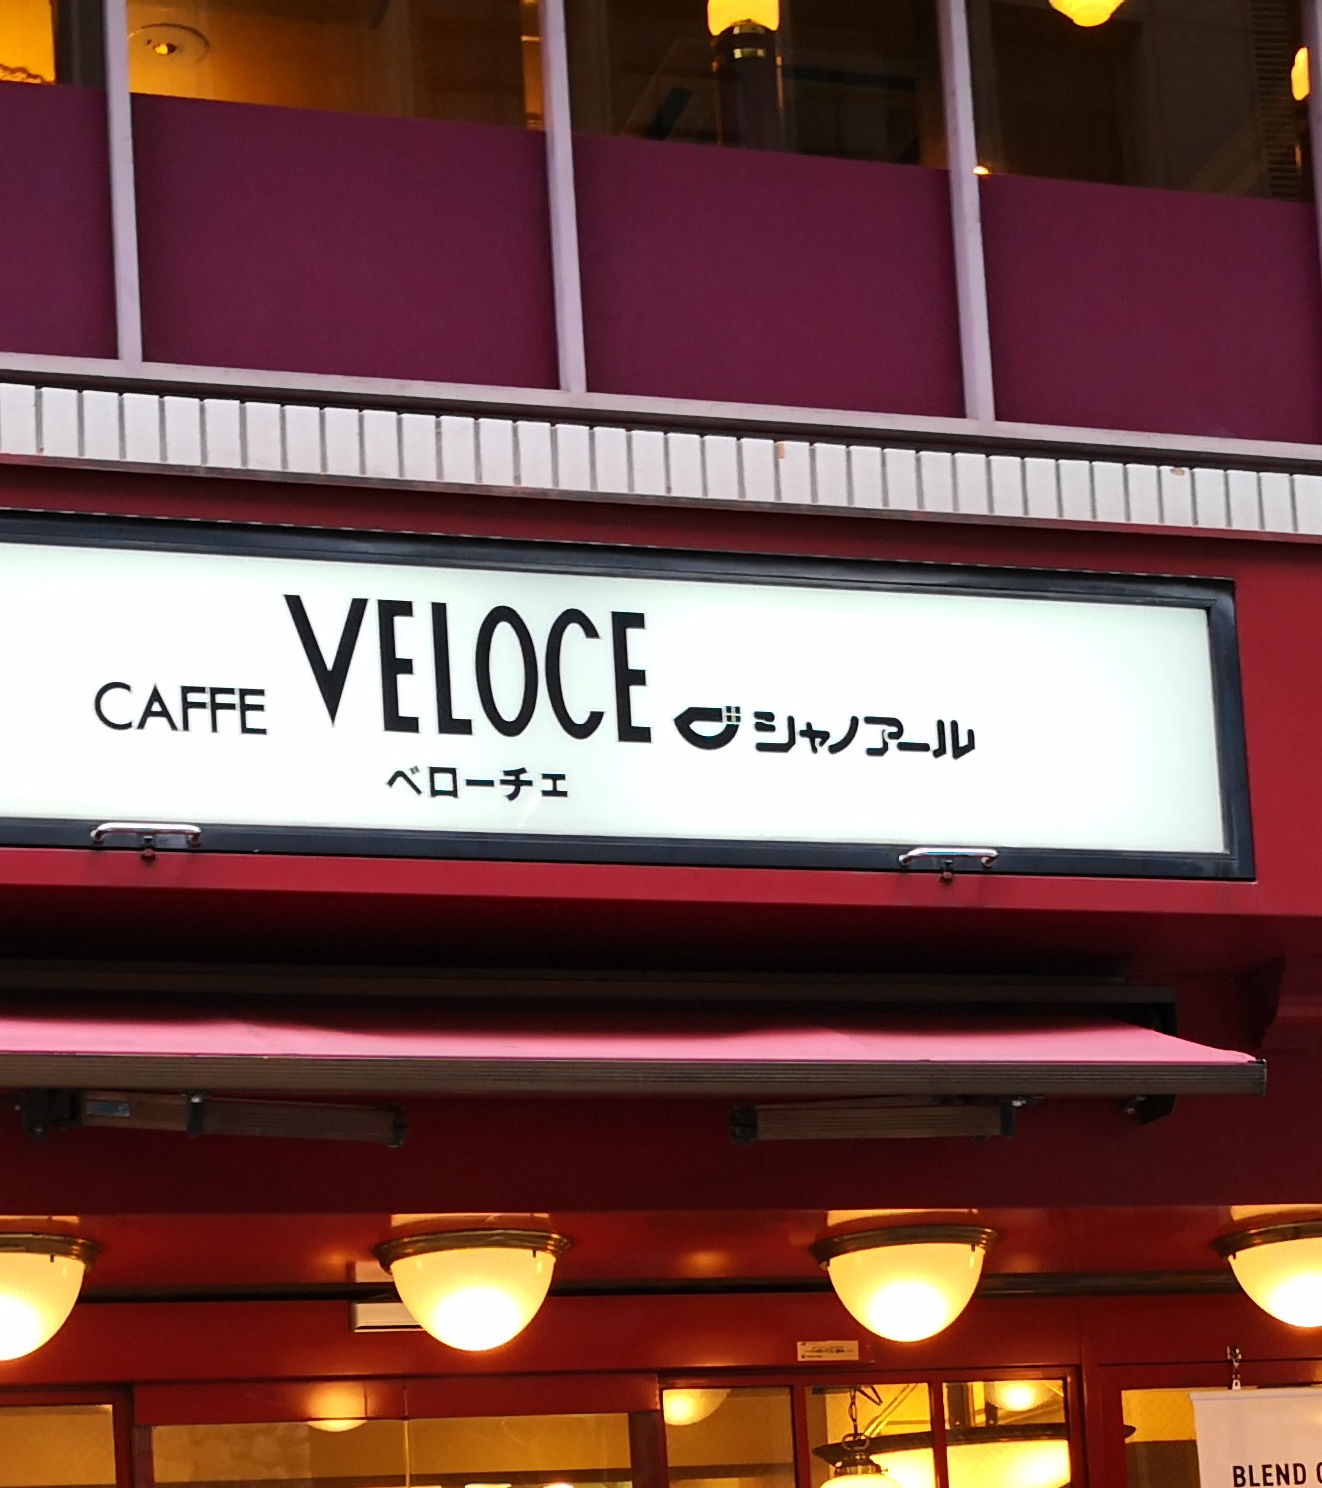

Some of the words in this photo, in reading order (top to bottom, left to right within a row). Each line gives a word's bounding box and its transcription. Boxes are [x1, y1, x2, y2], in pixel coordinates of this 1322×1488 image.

[94, 681, 267, 735] CAFFE
[283, 594, 652, 743] VELOCE
[754, 710, 975, 760] シャノアール
[387, 766, 568, 800] ベローチェ
[1232, 1463, 1307, 1488] BLEND
